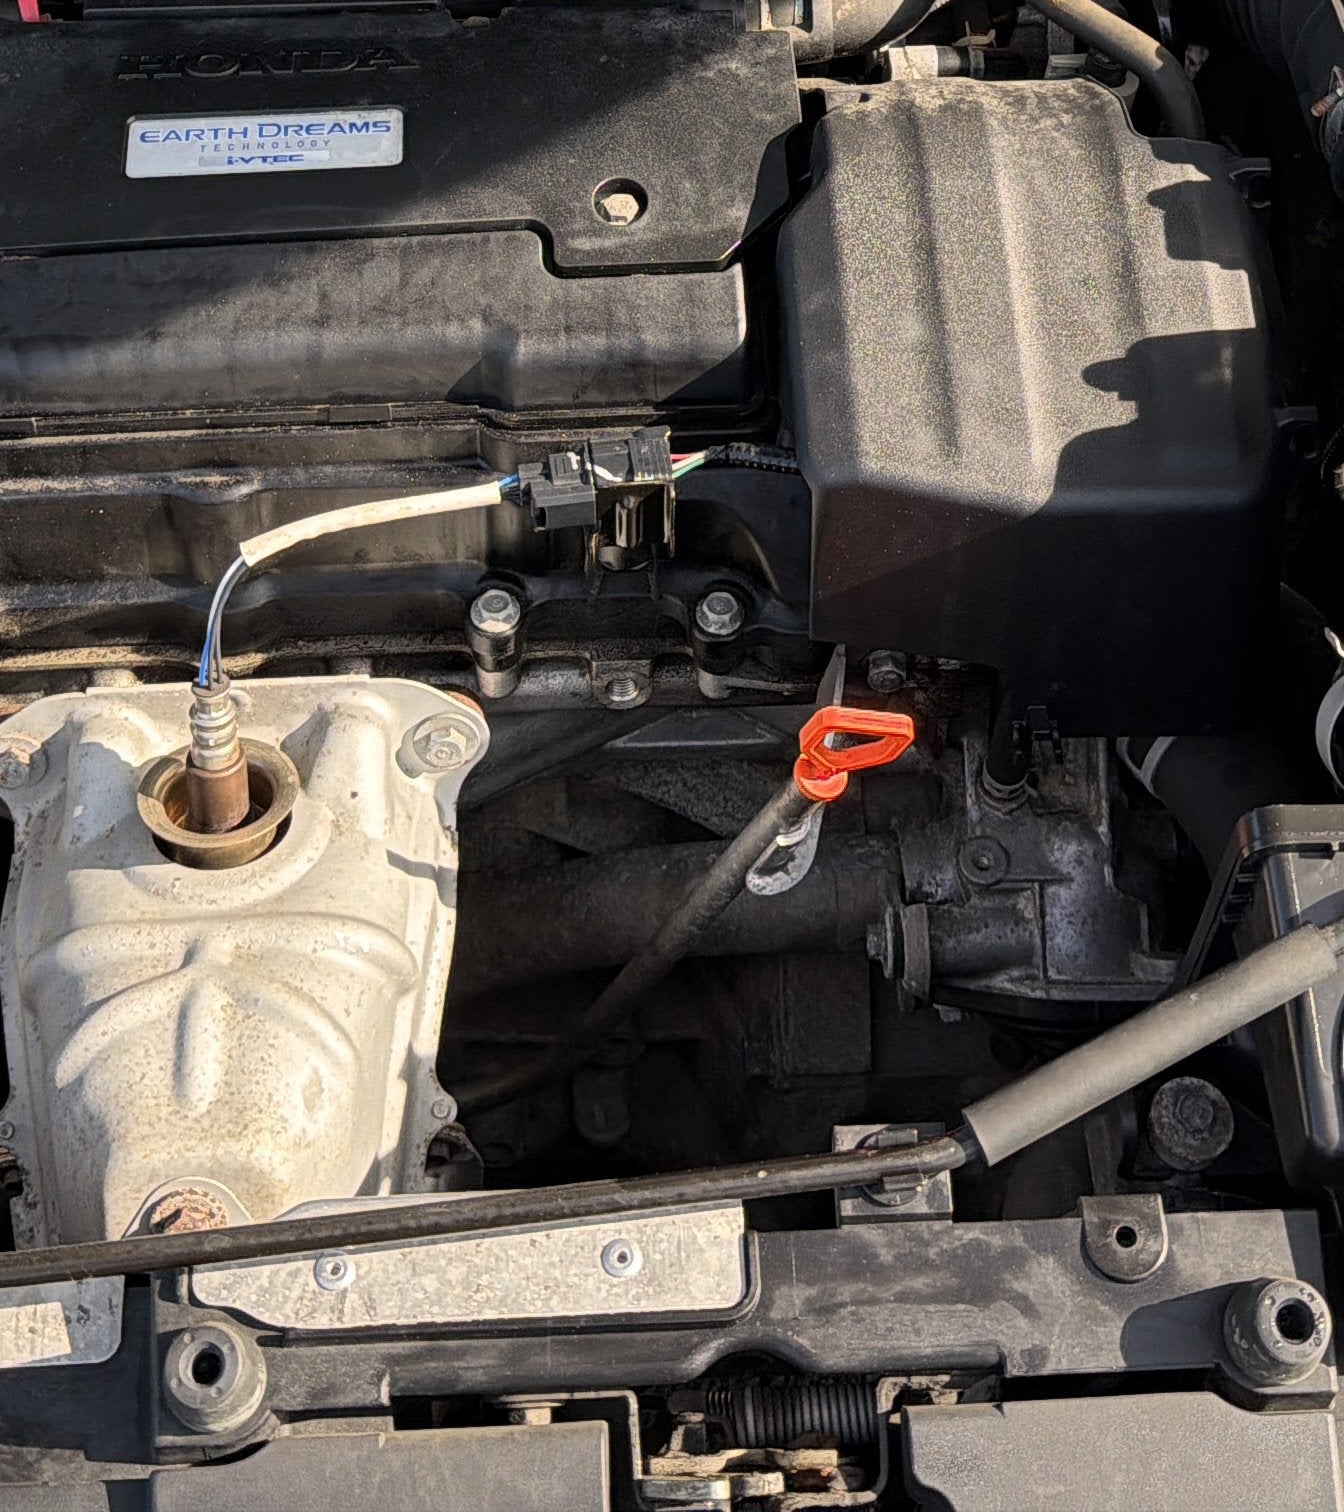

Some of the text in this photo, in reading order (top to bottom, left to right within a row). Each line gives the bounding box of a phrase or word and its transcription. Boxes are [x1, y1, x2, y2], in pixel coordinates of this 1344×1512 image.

[115, 47, 420, 81] HONDA
[139, 120, 393, 145] EARTH DREAMS
[200, 139, 331, 153] TECHNOLOGY
[226, 154, 305, 167] i-VTEC
